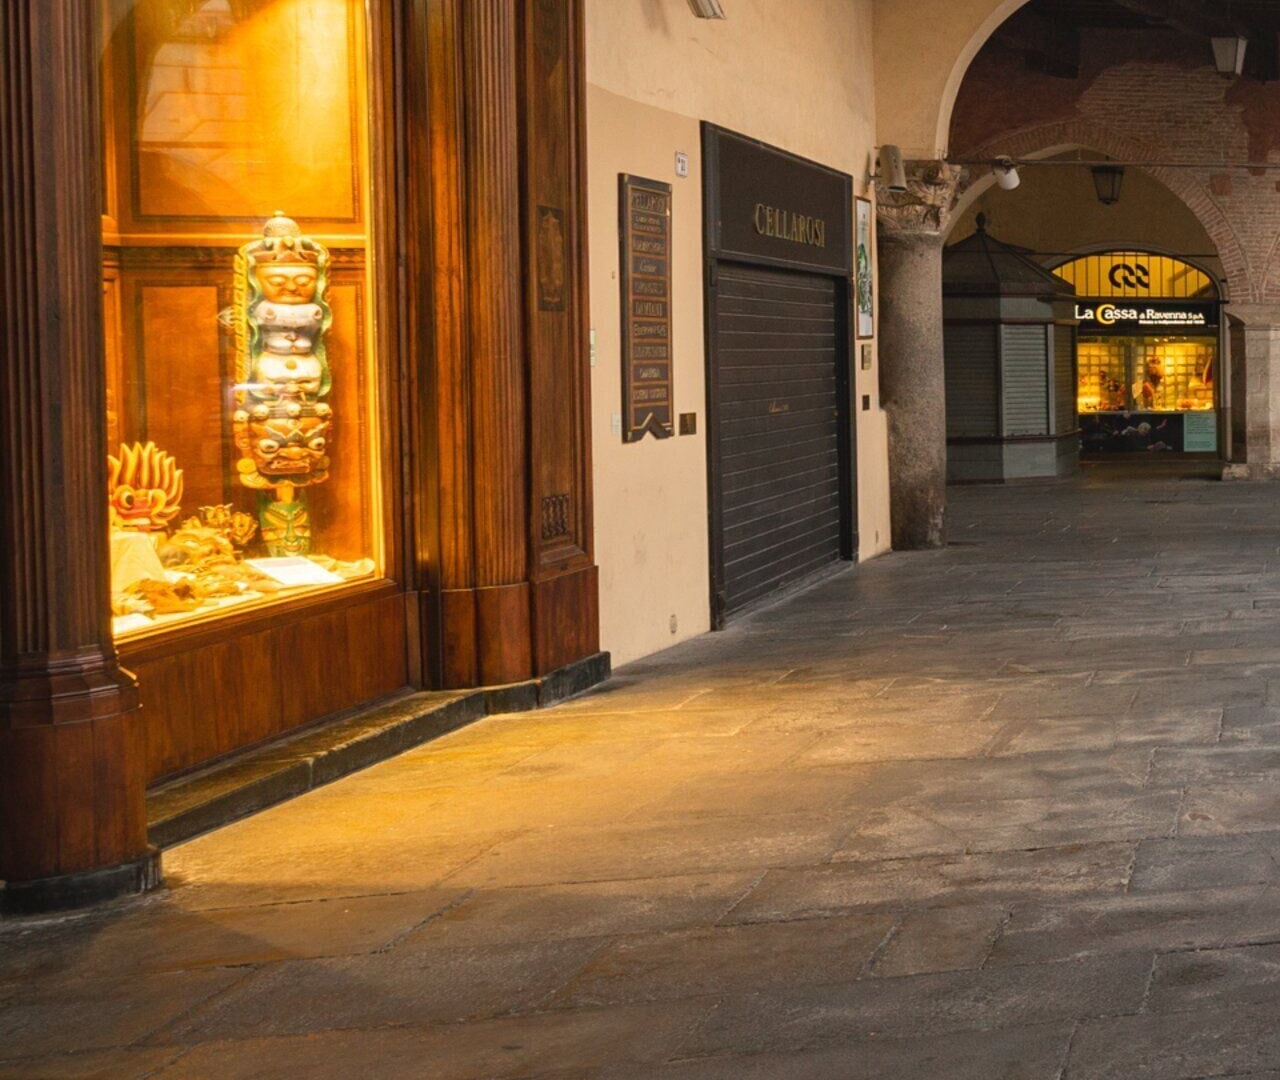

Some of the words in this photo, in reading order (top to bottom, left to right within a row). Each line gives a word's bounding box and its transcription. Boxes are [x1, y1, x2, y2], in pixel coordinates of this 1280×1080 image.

[755, 203, 825, 248] CELLAROSI
[1074, 304, 1094, 320] La
[1096, 303, 1138, 325] Cassa
[1146, 308, 1187, 320] Ravenna
